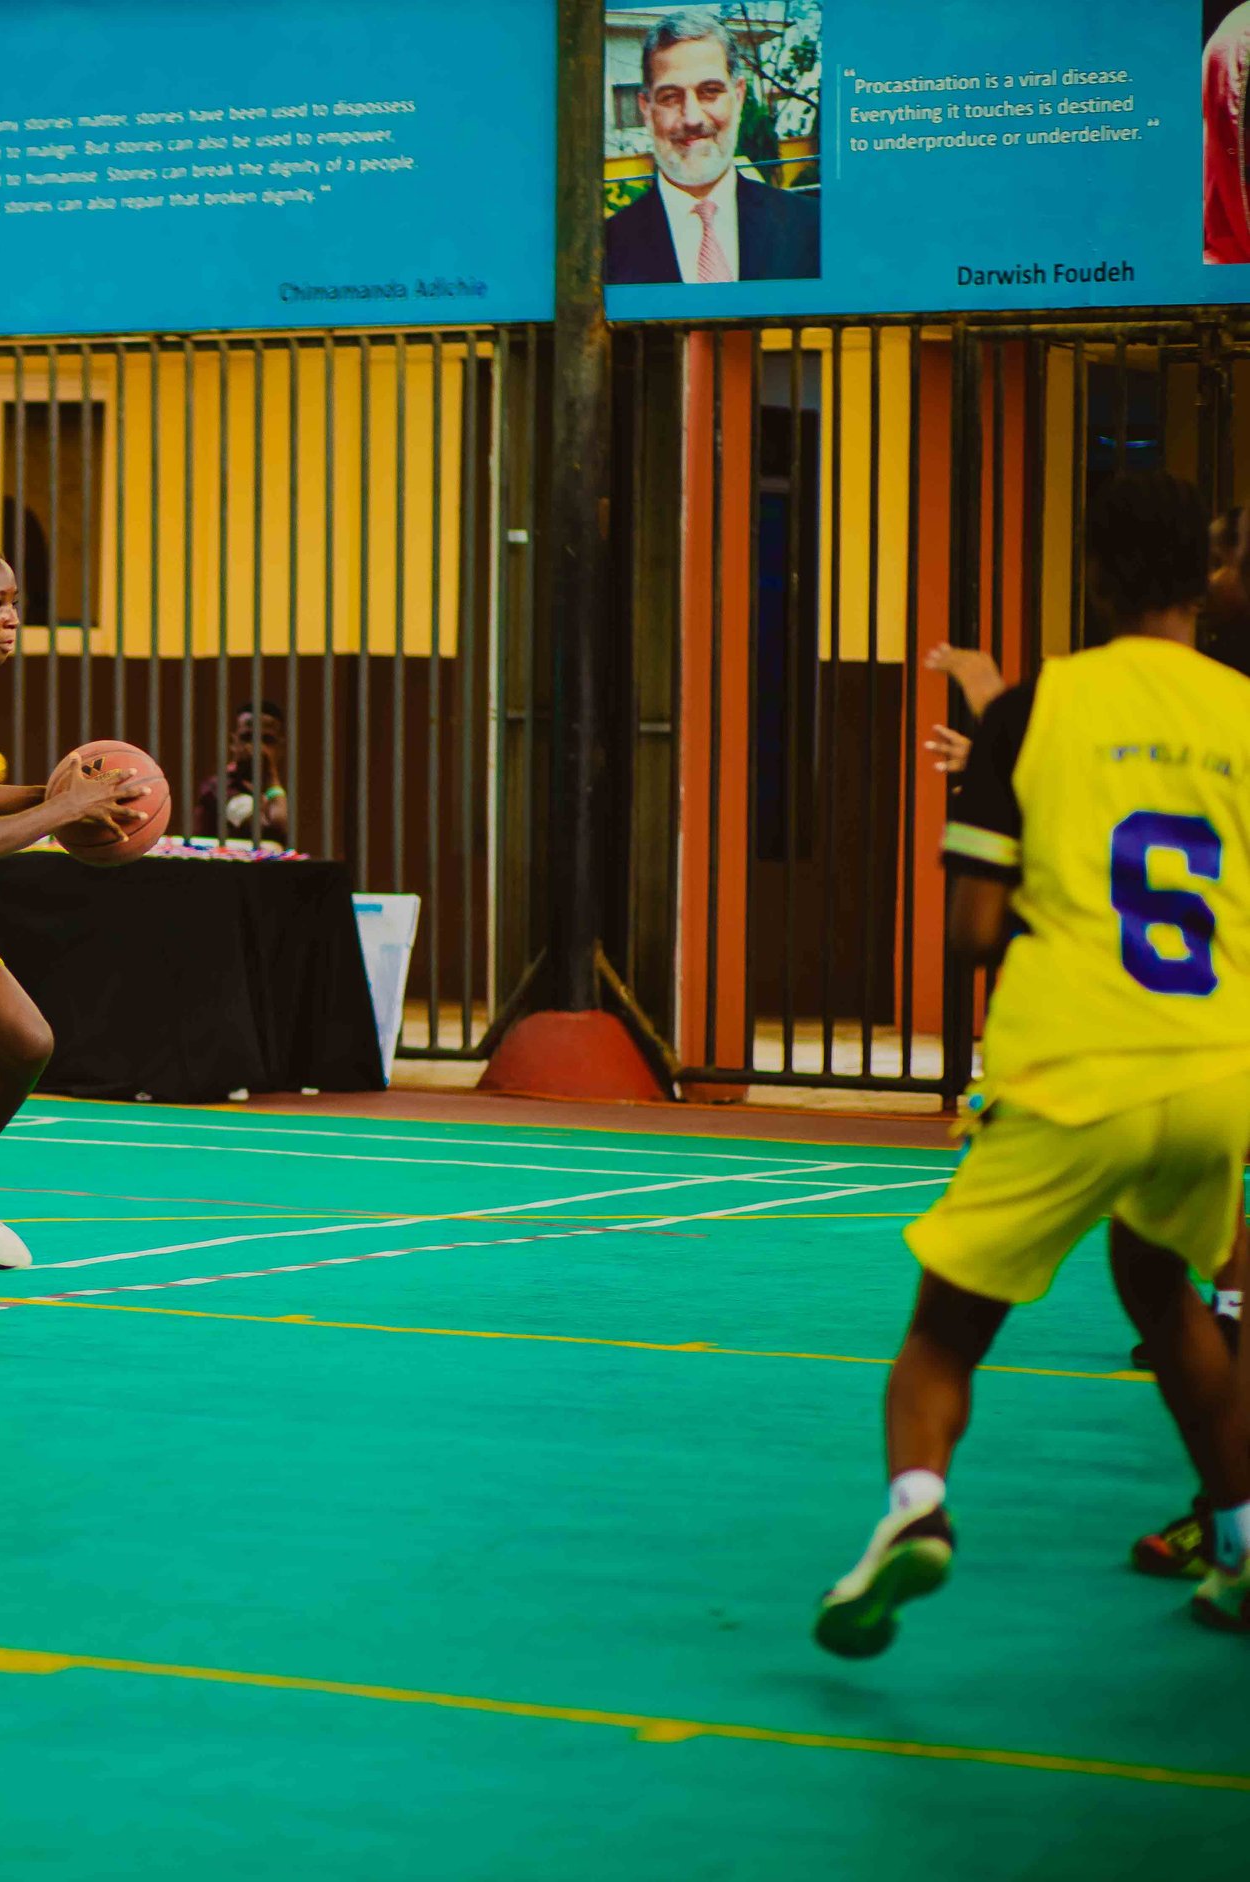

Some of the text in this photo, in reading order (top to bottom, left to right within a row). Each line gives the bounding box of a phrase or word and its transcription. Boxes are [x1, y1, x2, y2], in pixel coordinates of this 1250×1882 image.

[985, 72, 999, 89] is
[1003, 75, 1014, 88] a
[1018, 70, 1057, 88] viral
[1062, 68, 1134, 86] disease.
[24, 117, 74, 131] stories
[135, 111, 185, 125] stories
[188, 109, 225, 122] have
[229, 107, 268, 121] been
[271, 103, 309, 119] used
[311, 103, 329, 117] to
[850, 95, 1135, 126] Everything it touches is destined
[5, 147, 22, 159] to
[84, 140, 110, 156] But
[114, 140, 164, 154] stories
[167, 138, 194, 152] can
[197, 136, 228, 151] also
[232, 135, 251, 149] be
[255, 132, 292, 148] used
[295, 132, 313, 146] to
[849, 137, 869, 152] to
[873, 131, 998, 152] underproduce
[1002, 133, 1022, 146] or
[5, 174, 22, 186] to
[161, 167, 188, 180] can
[191, 163, 234, 178] break
[238, 162, 264, 176] the
[325, 156, 342, 173] of
[345, 159, 356, 172] a
[3, 201, 53, 214] stories
[57, 199, 83, 212] can
[86, 196, 117, 211] also
[168, 193, 200, 207] that
[203, 191, 257, 206] broken
[957, 260, 1136, 287] Darwish Foudeh
[1110, 809, 1223, 997] 6
